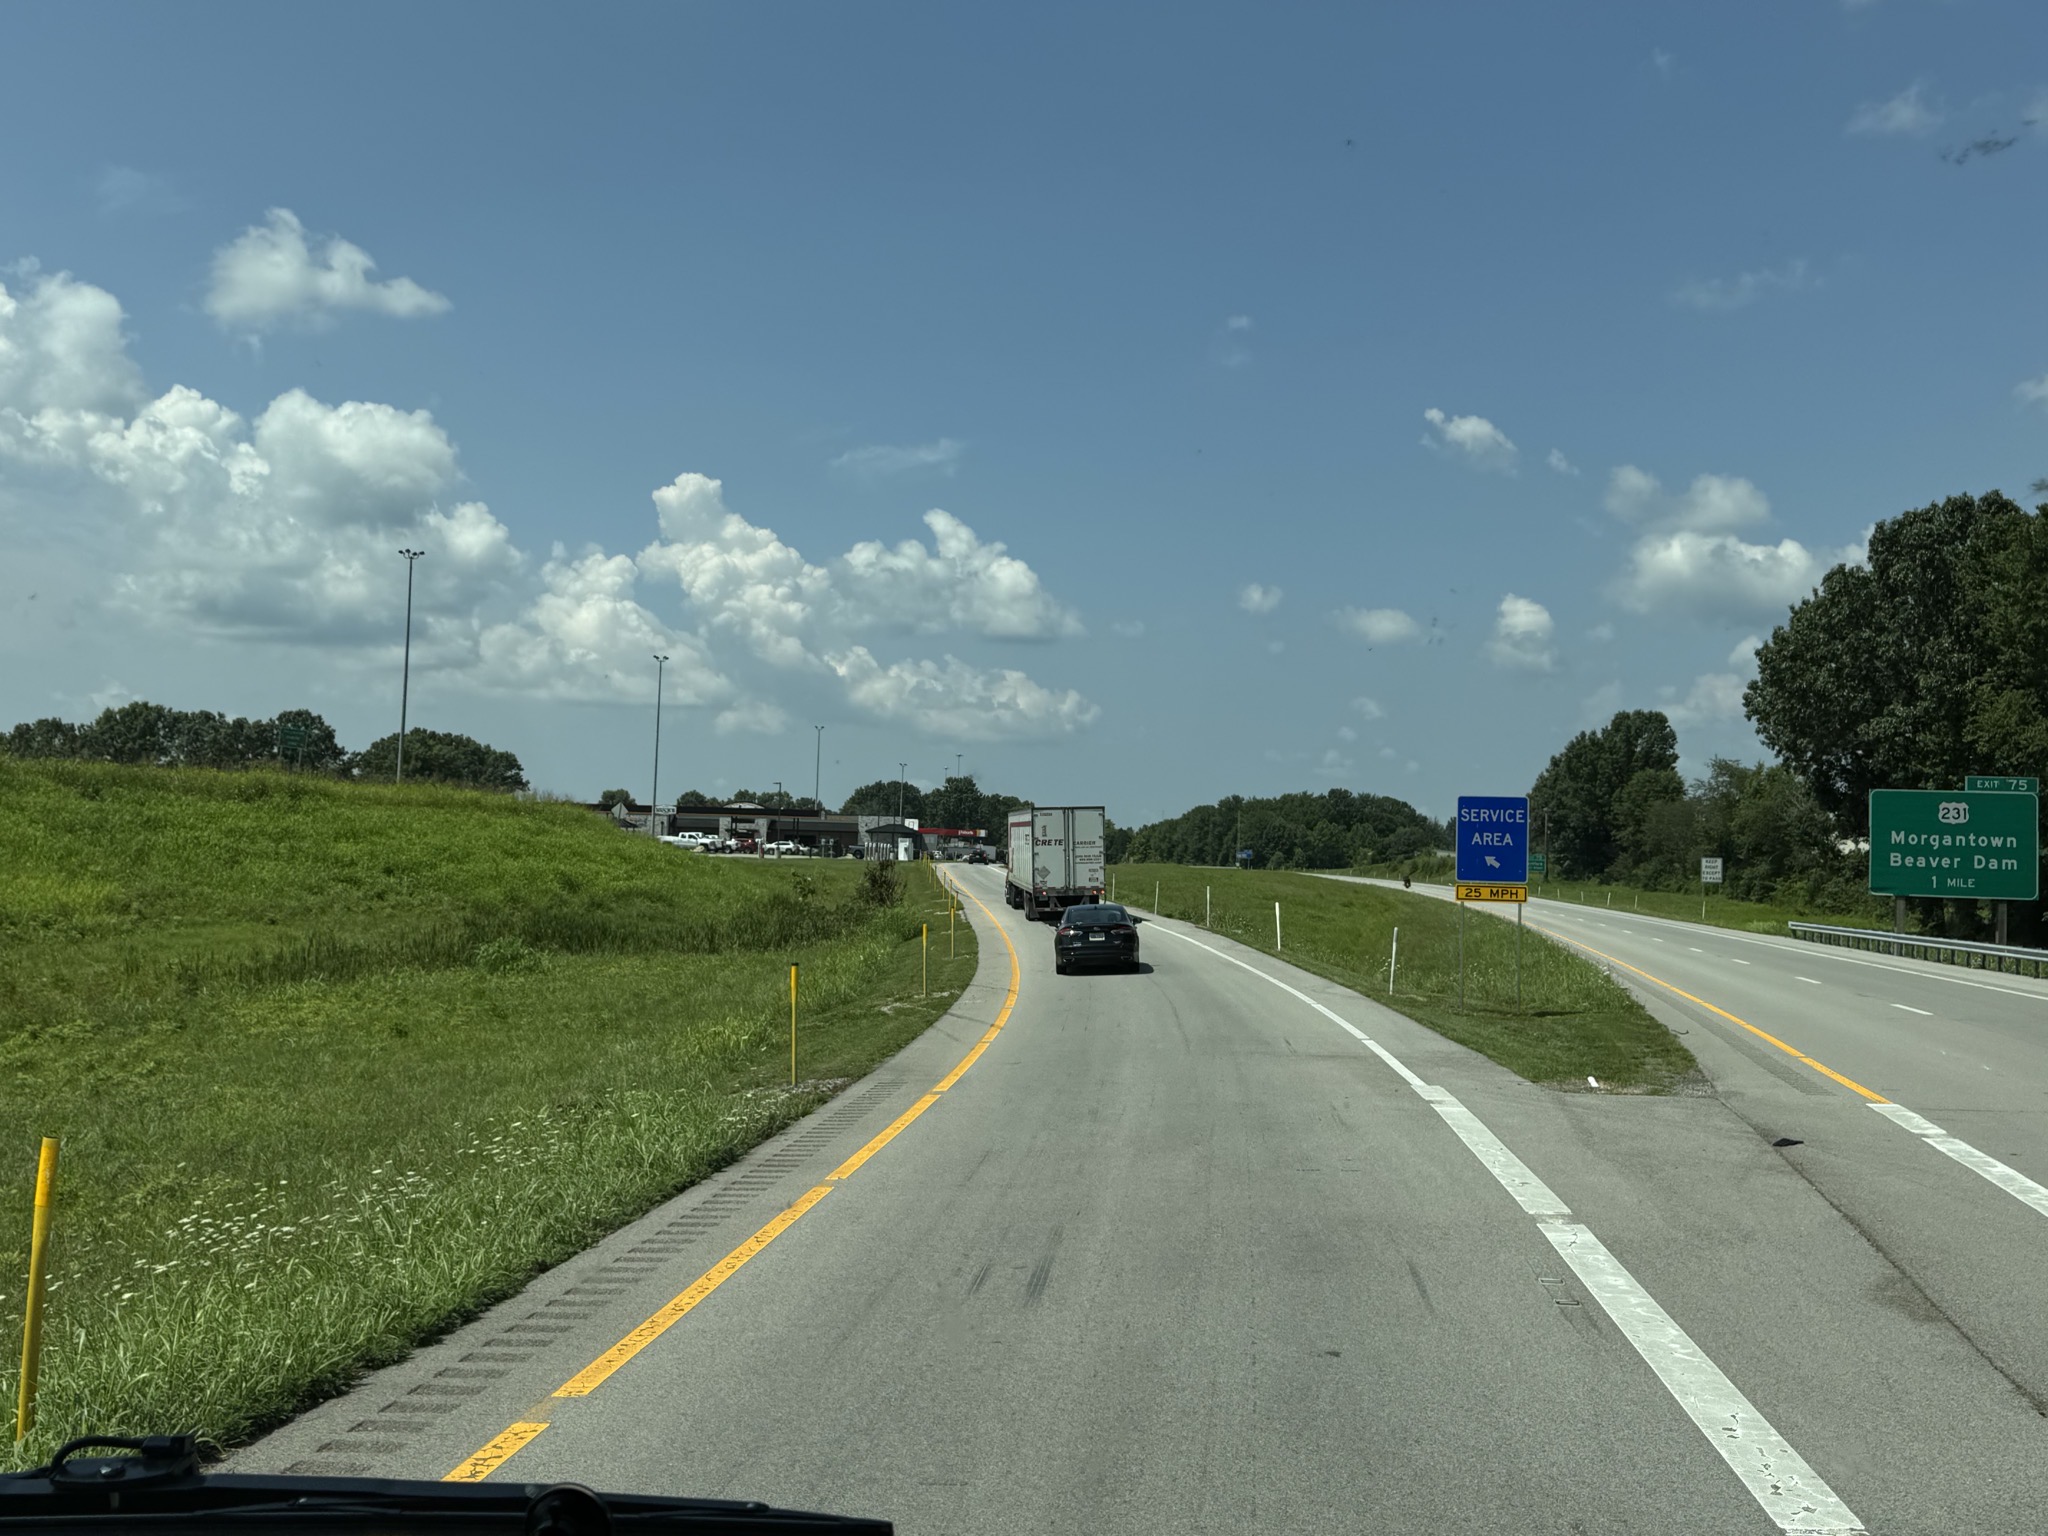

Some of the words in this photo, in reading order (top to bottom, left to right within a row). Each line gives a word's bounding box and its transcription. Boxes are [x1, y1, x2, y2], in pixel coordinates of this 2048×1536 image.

[1976, 780, 1999, 788] EXIT
[2007, 779, 2028, 790] 75
[1461, 809, 1525, 822] SERVICE
[1941, 807, 1967, 820] 231
[1471, 832, 1513, 846] AREA
[1891, 831, 2017, 850] Morgantown
[1889, 852, 1961, 868] Beaver
[1974, 855, 2018, 870] Dam
[1931, 876, 1937, 888] 1
[1947, 878, 1975, 888] MILE
[1465, 888, 1482, 898] 25
[1490, 889, 1518, 899] MPH
